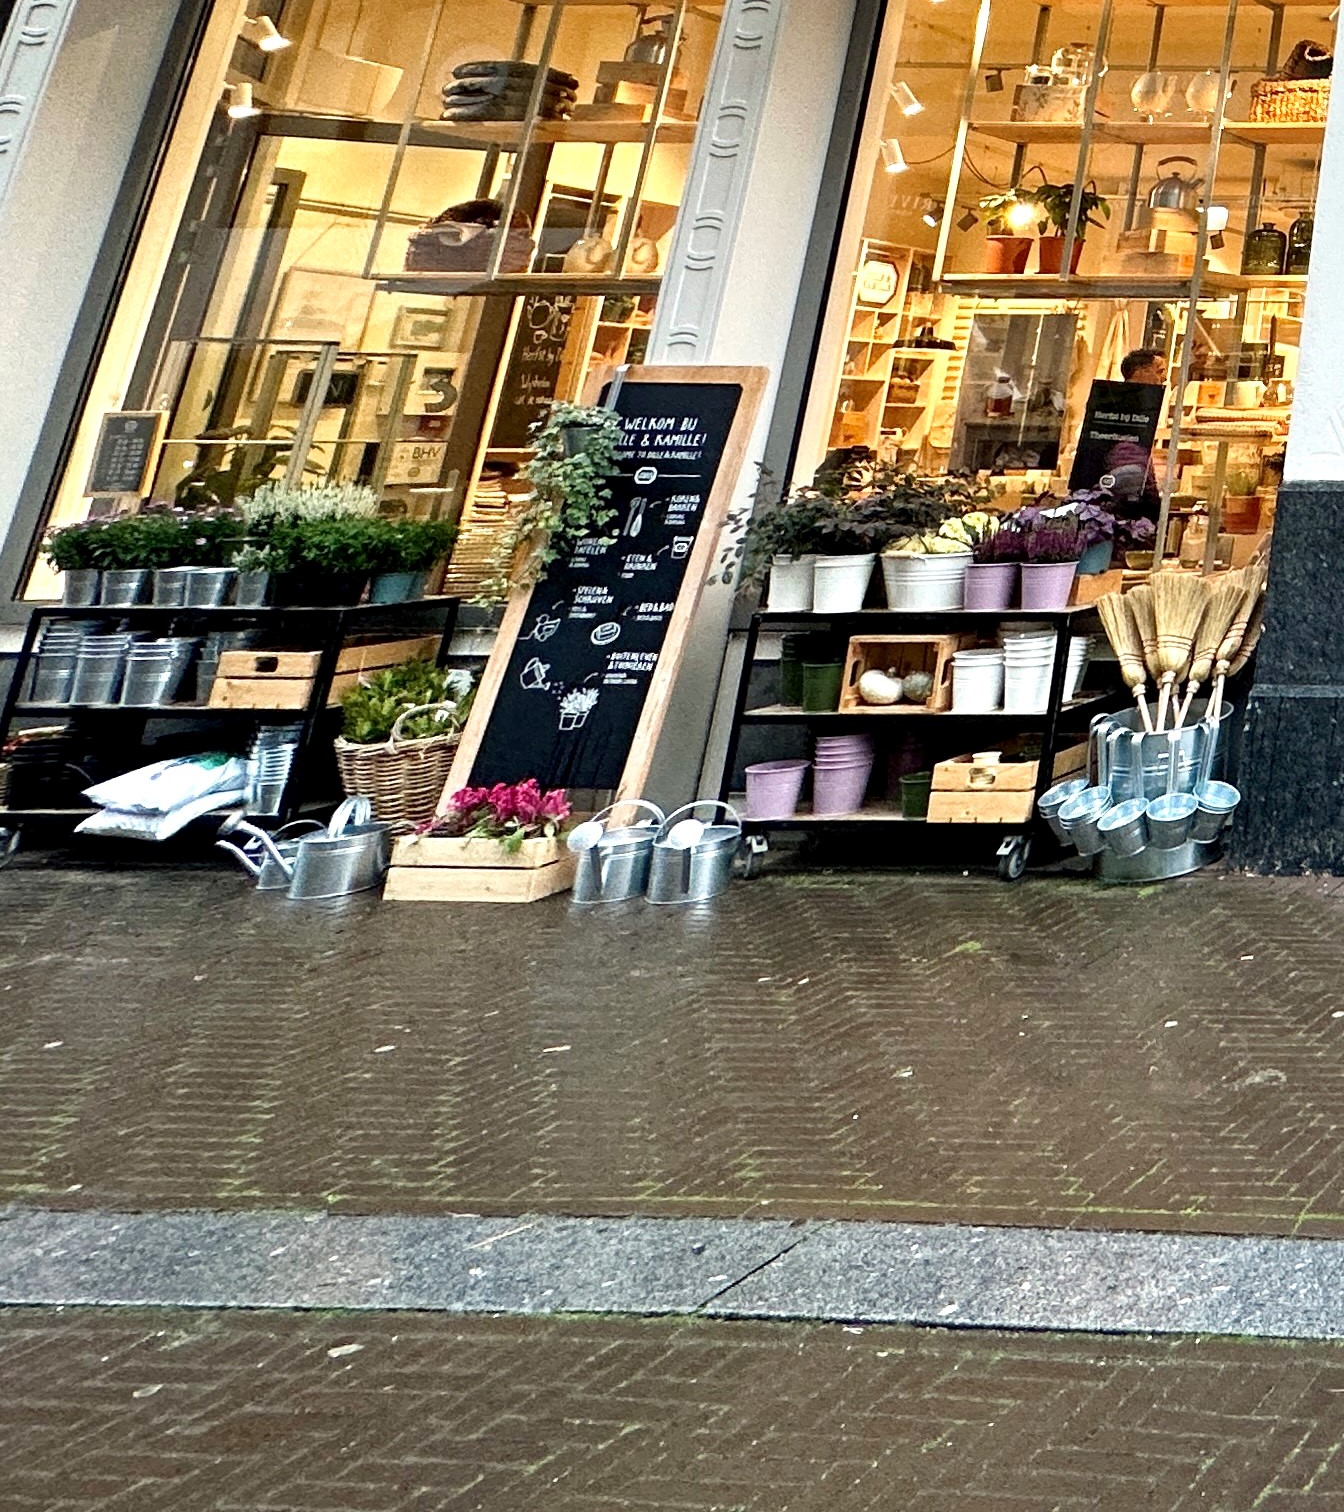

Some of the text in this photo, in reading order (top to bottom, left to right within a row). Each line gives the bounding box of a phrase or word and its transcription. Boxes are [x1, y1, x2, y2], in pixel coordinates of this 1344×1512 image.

[624, 417, 675, 430] WELKOM
[641, 435, 650, 447] &
[654, 433, 707, 446] KAMILLE!
[412, 446, 441, 459] BHV
